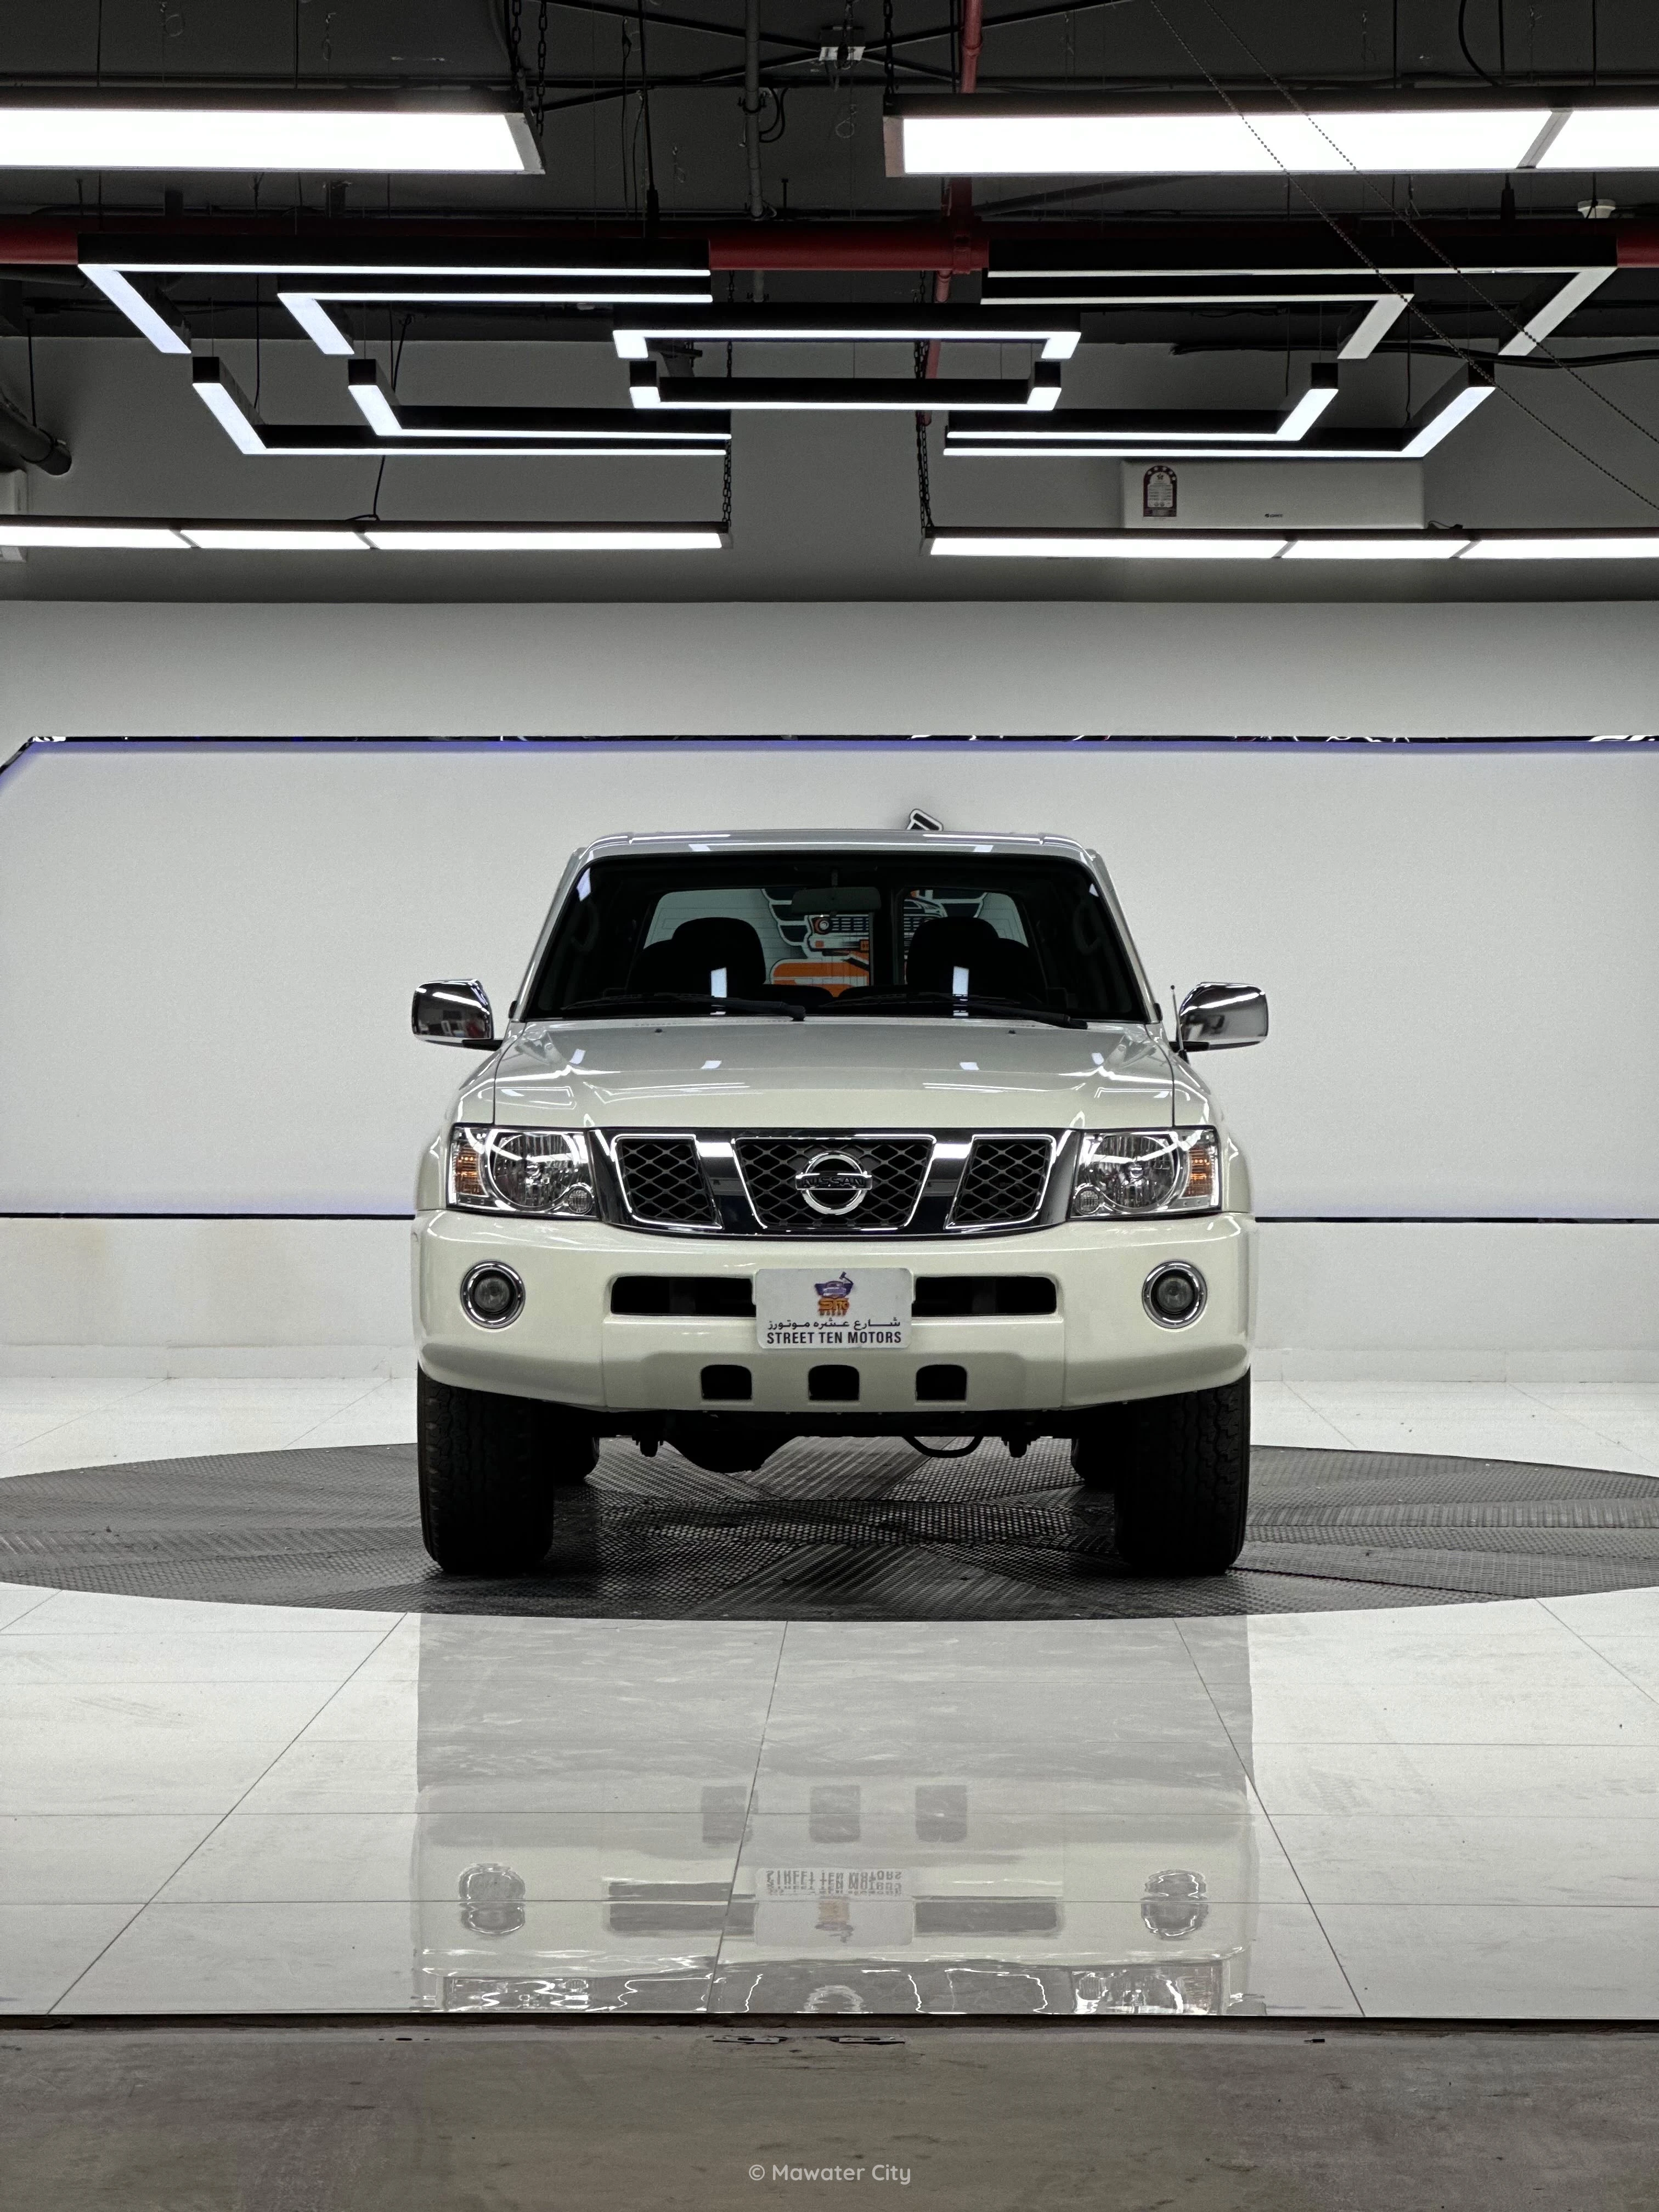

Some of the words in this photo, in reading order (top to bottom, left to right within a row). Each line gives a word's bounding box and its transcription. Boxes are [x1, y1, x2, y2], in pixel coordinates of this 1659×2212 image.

[803, 1176, 865, 1187] NISSAN
[768, 1320, 810, 1330] موتورز
[854, 1317, 900, 1330] شارع
[767, 1331, 814, 1344] STREET
[819, 1331, 842, 1344] TEN
[848, 1331, 901, 1344] MOTORS
